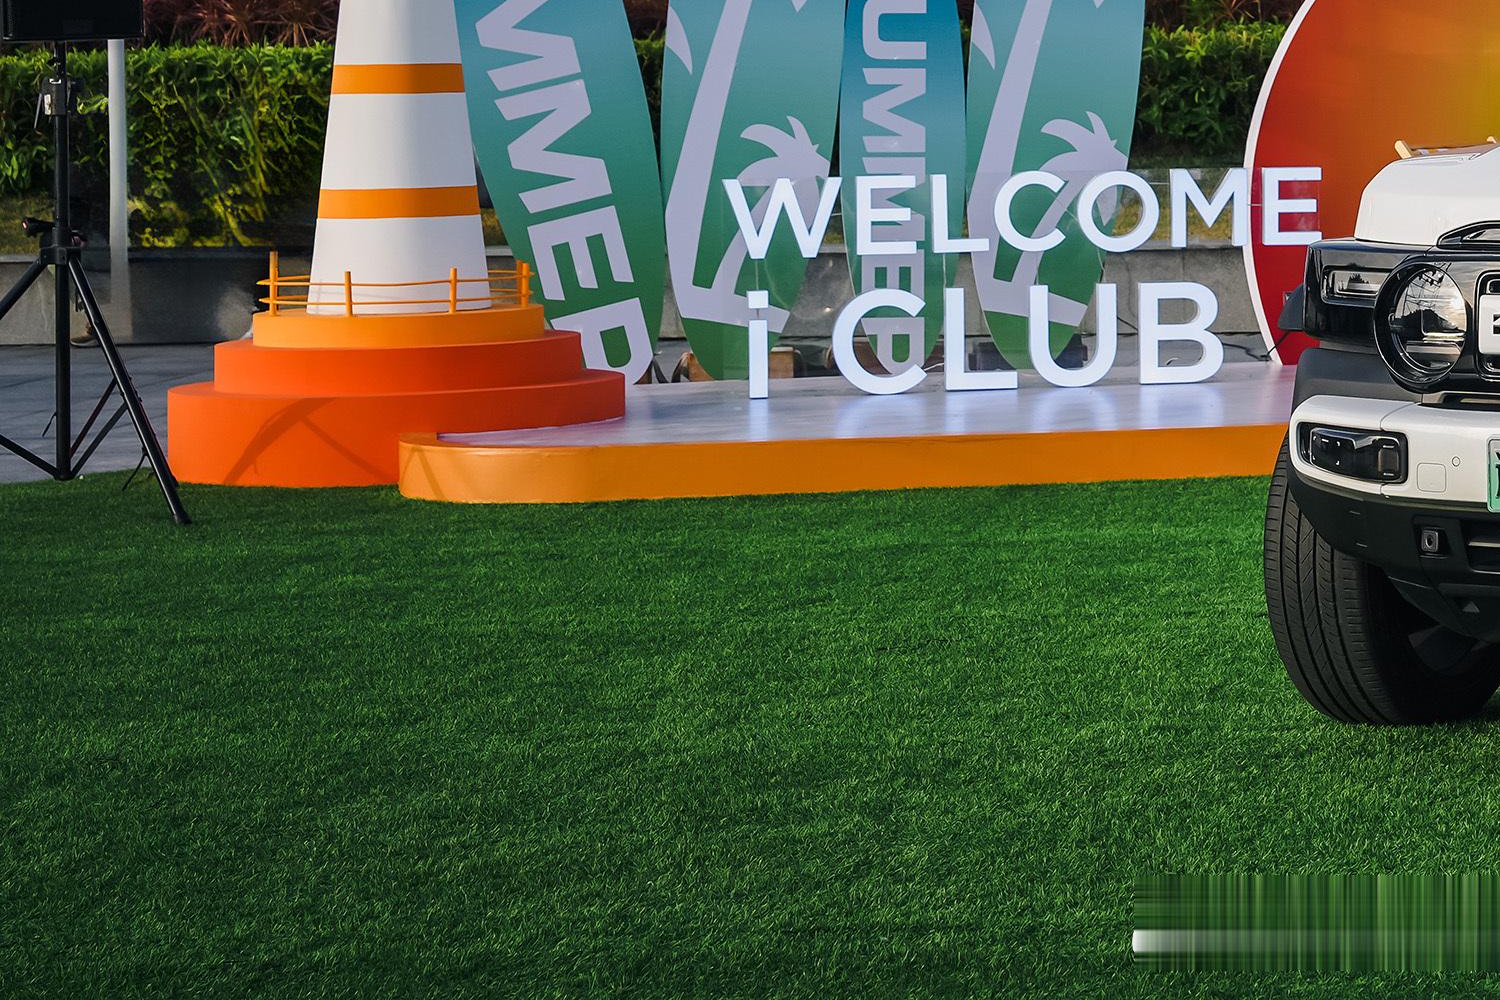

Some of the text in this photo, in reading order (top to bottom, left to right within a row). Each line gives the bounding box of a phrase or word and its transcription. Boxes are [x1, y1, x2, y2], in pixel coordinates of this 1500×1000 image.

[722, 166, 1323, 259] WELCOME
[746, 280, 1225, 399] i CLUB
